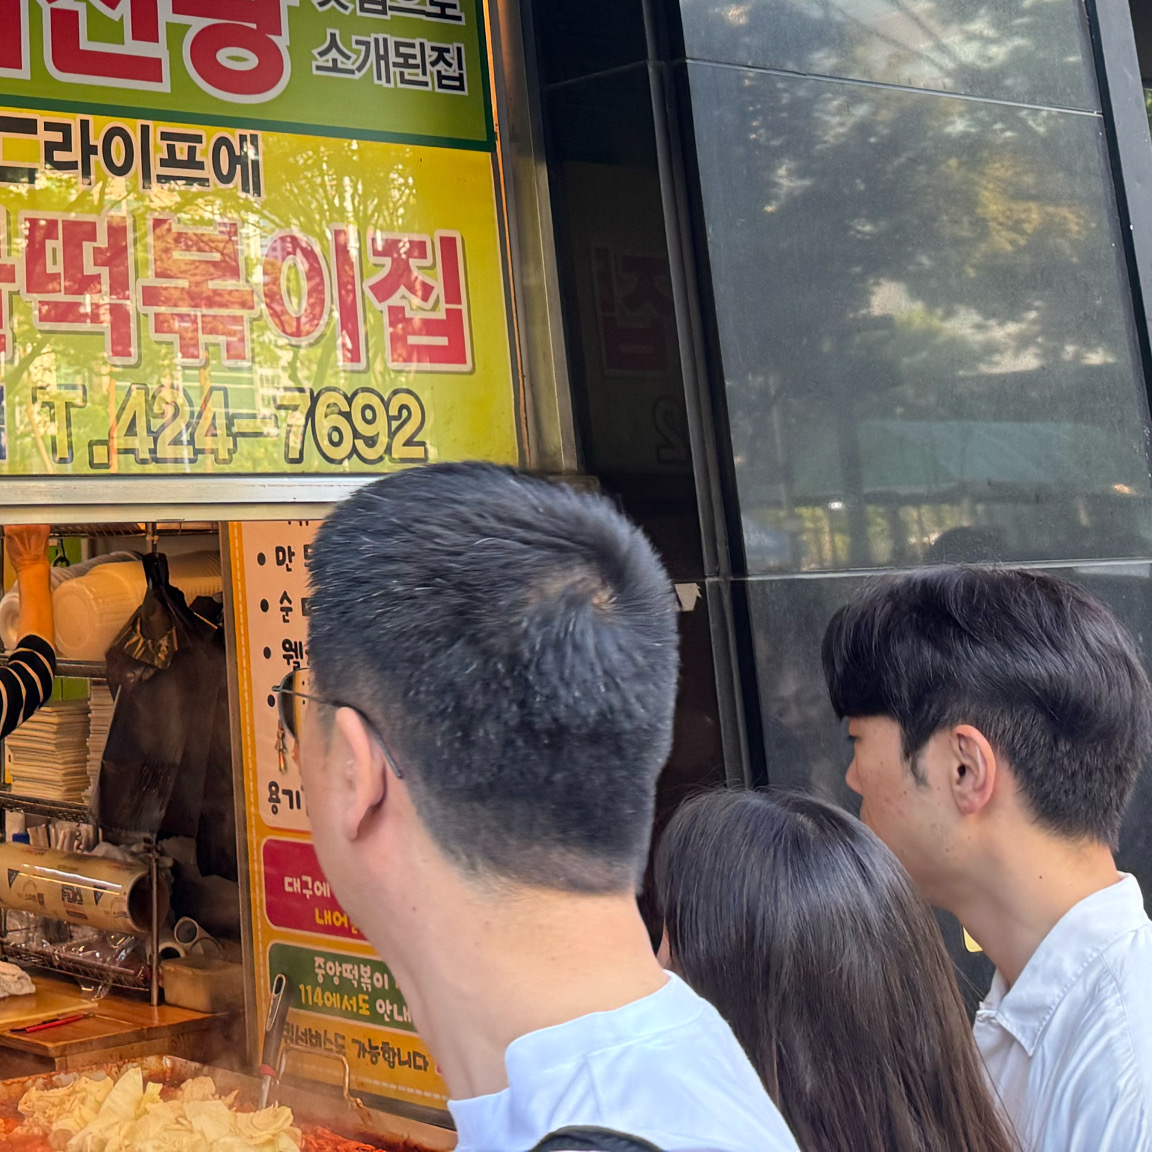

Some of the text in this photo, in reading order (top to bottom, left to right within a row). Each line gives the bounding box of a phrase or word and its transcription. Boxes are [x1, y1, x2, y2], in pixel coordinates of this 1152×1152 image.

[312, 29, 469, 97] 소개된집
[268, 781, 303, 815] 용기
[284, 875, 331, 899] 대구에
[314, 956, 389, 992] 중앙떡볶이
[299, 984, 371, 1016] 114에서도
[351, 1037, 430, 1071] 가능합니다
